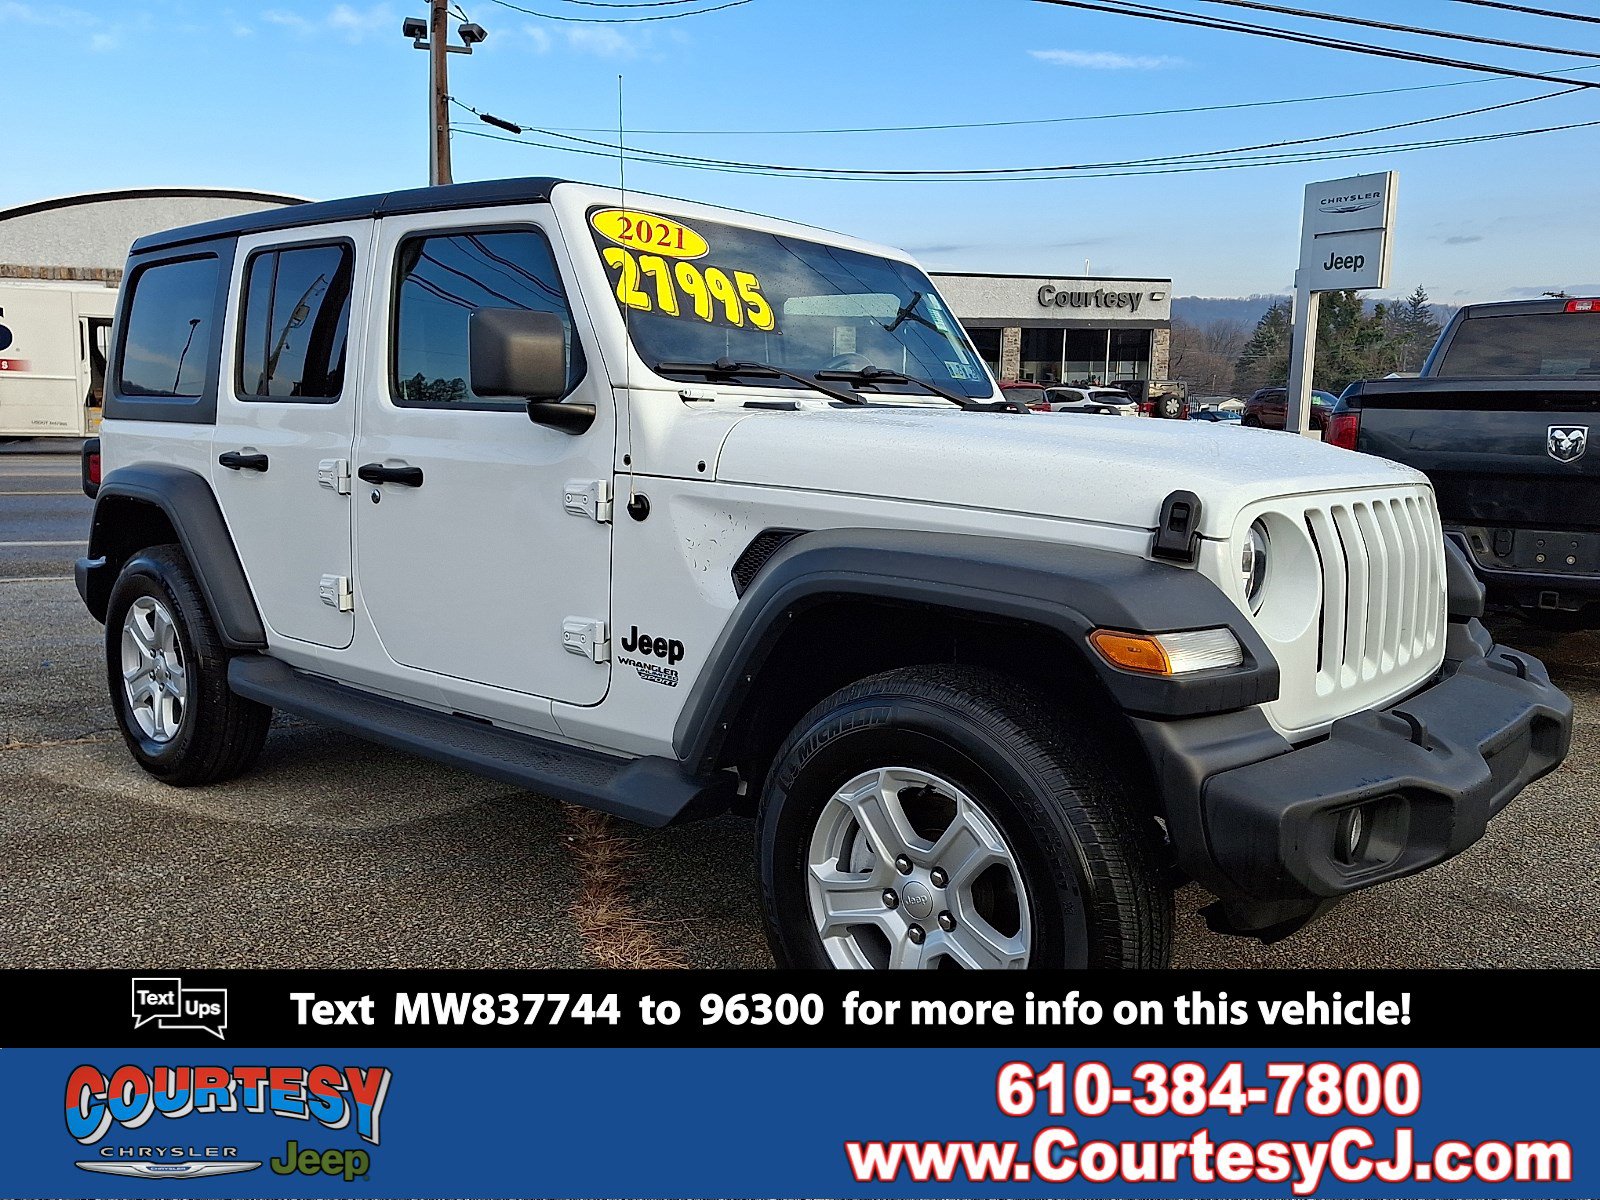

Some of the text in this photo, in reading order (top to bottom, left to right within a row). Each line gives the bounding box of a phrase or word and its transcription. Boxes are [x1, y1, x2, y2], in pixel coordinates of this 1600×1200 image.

[1320, 191, 1381, 205] CHRYSLER
[617, 216, 686, 250] 2021
[1323, 252, 1365, 273] Jeep
[602, 247, 776, 331] 27995
[1038, 284, 1144, 313] Courtesy
[621, 625, 685, 666] Jeep
[617, 655, 679, 678] WRANGLER
[799, 705, 892, 764] MICHELIN
[905, 895, 928, 906] Jeep
